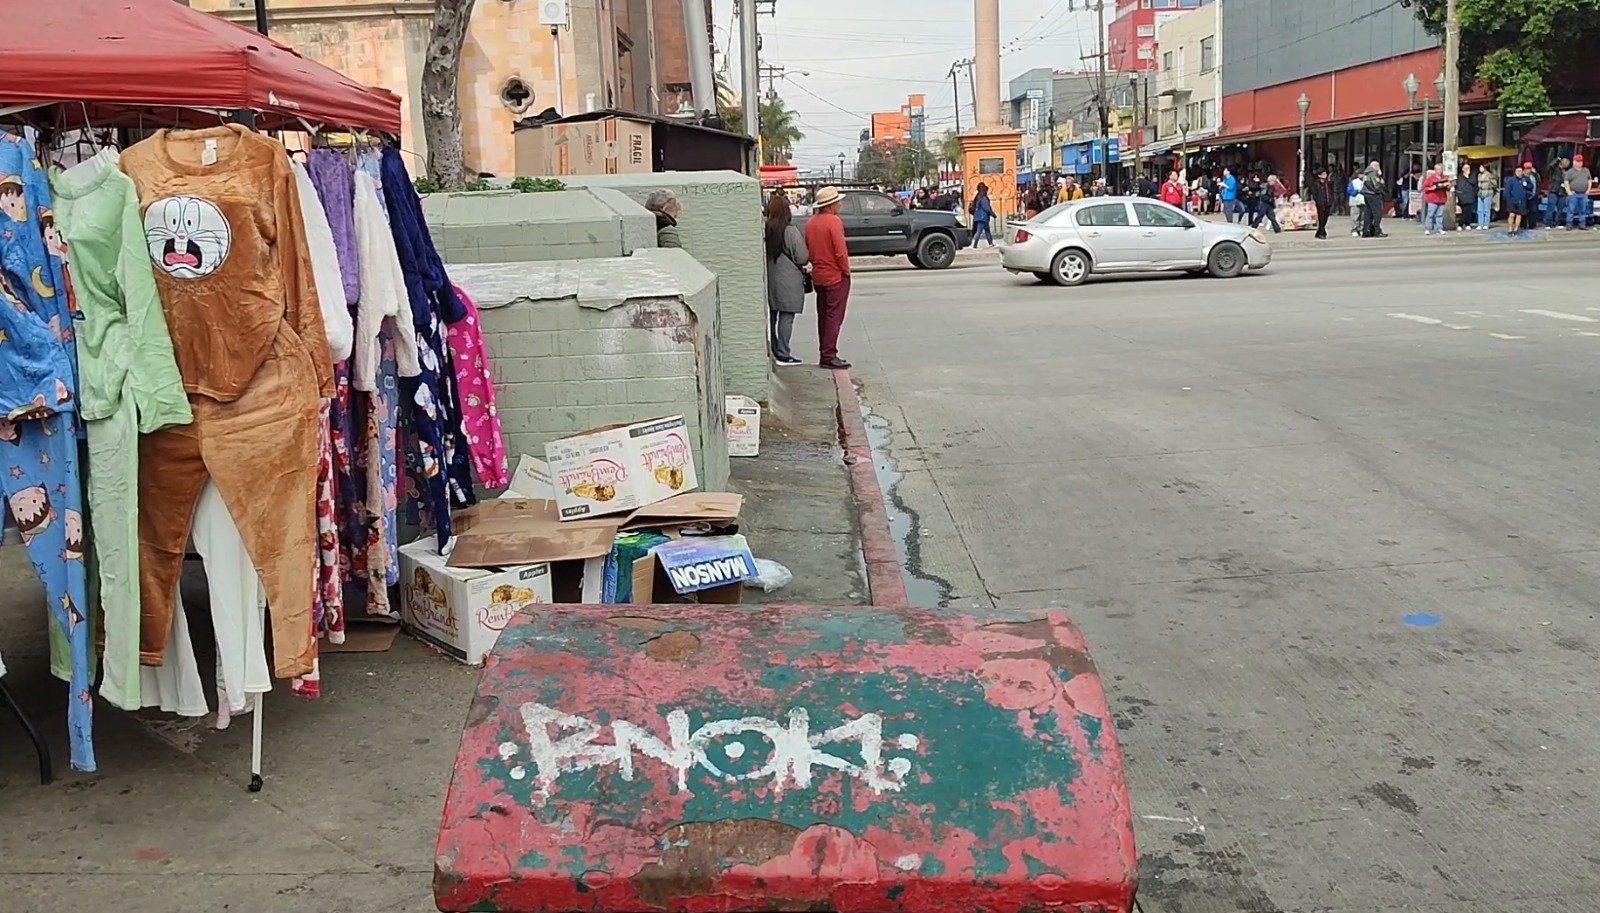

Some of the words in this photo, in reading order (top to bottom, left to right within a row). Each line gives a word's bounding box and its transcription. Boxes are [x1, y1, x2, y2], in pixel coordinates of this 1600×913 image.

[632, 134, 643, 165] FRÁGIL
[557, 458, 628, 489] RemBrandt
[565, 506, 587, 516] Apples
[522, 568, 546, 579] Apples
[671, 556, 748, 588] MANSON
[405, 583, 460, 632] RemBrandt
